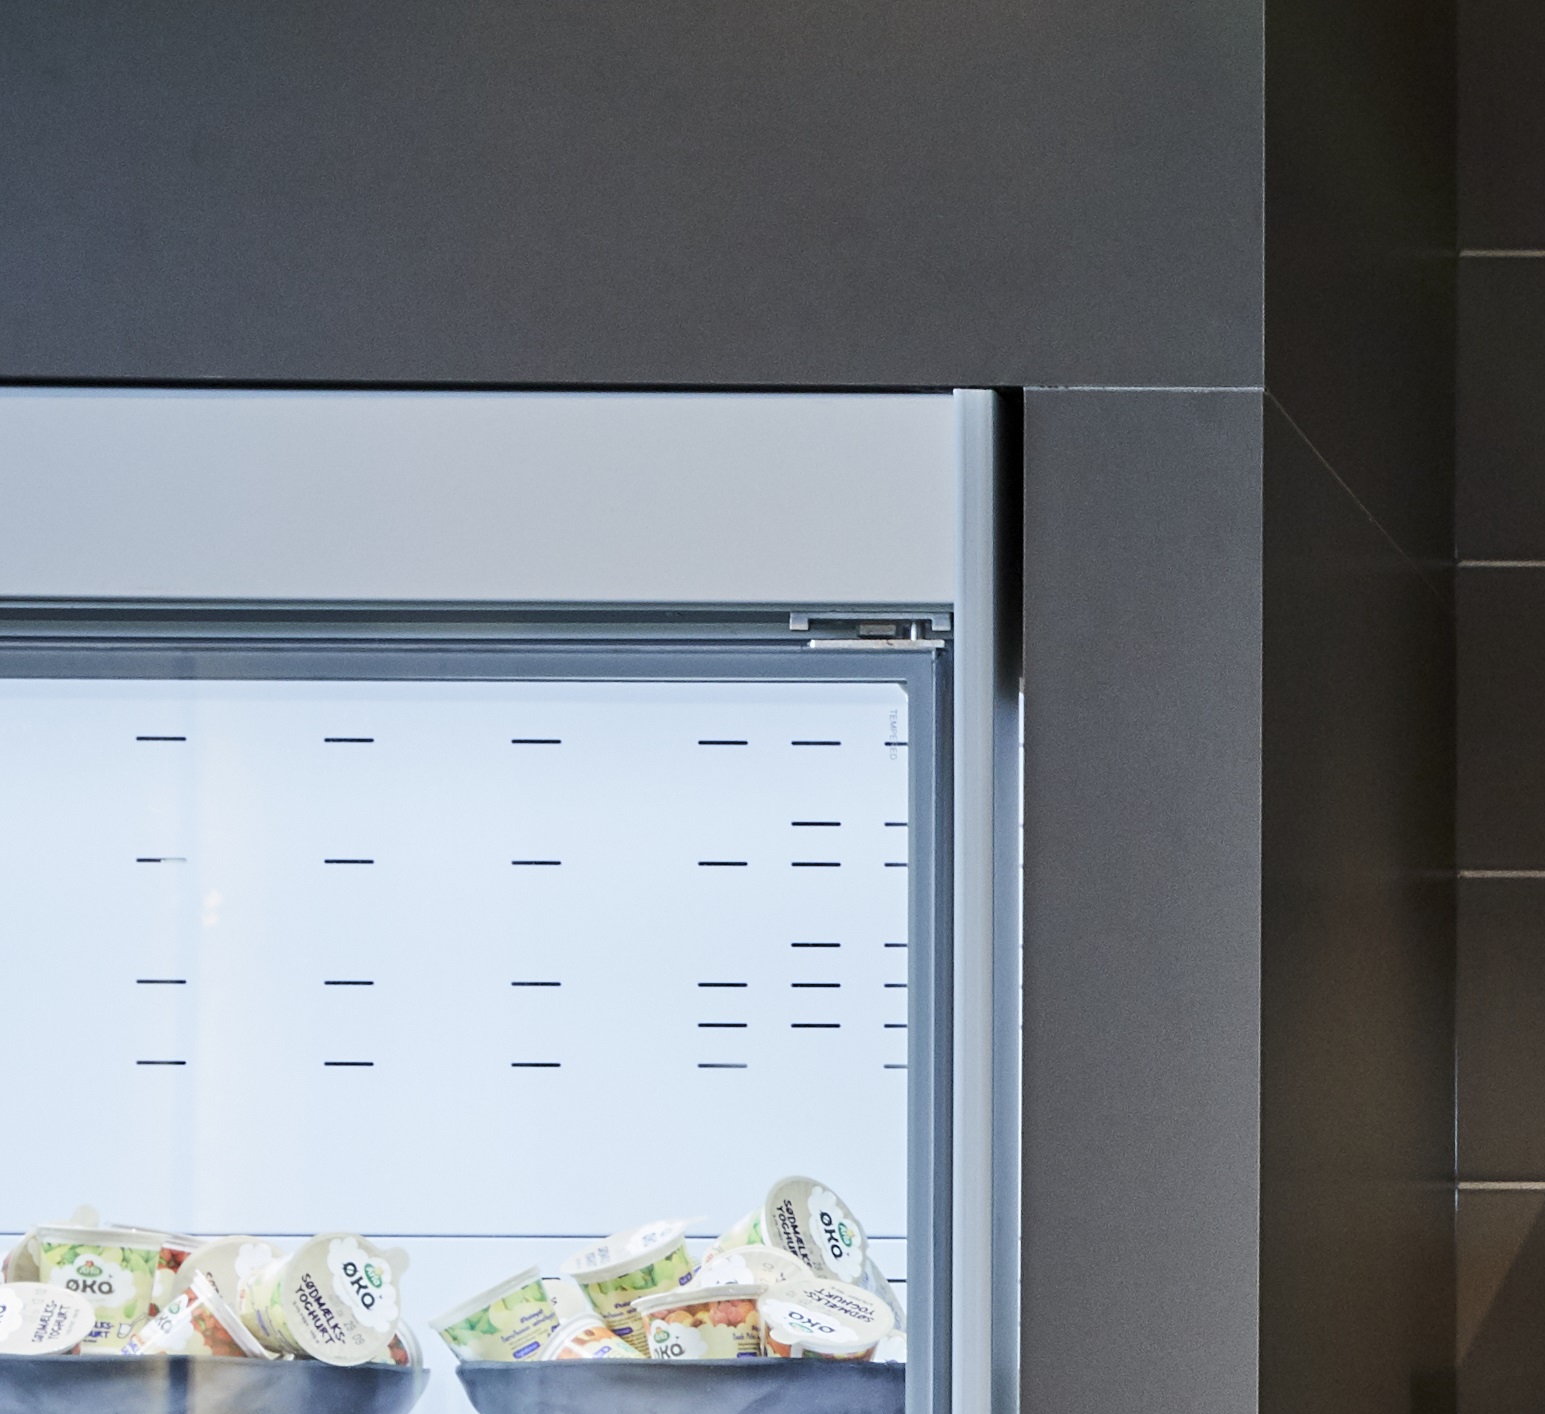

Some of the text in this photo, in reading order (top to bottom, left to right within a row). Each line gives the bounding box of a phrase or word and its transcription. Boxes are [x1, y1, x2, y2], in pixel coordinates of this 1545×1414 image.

[819, 1210, 843, 1260] ØKO
[65, 1278, 115, 1295] ØKO
[342, 1261, 375, 1311] ØKO
[295, 1285, 335, 1344] YOGHURT
